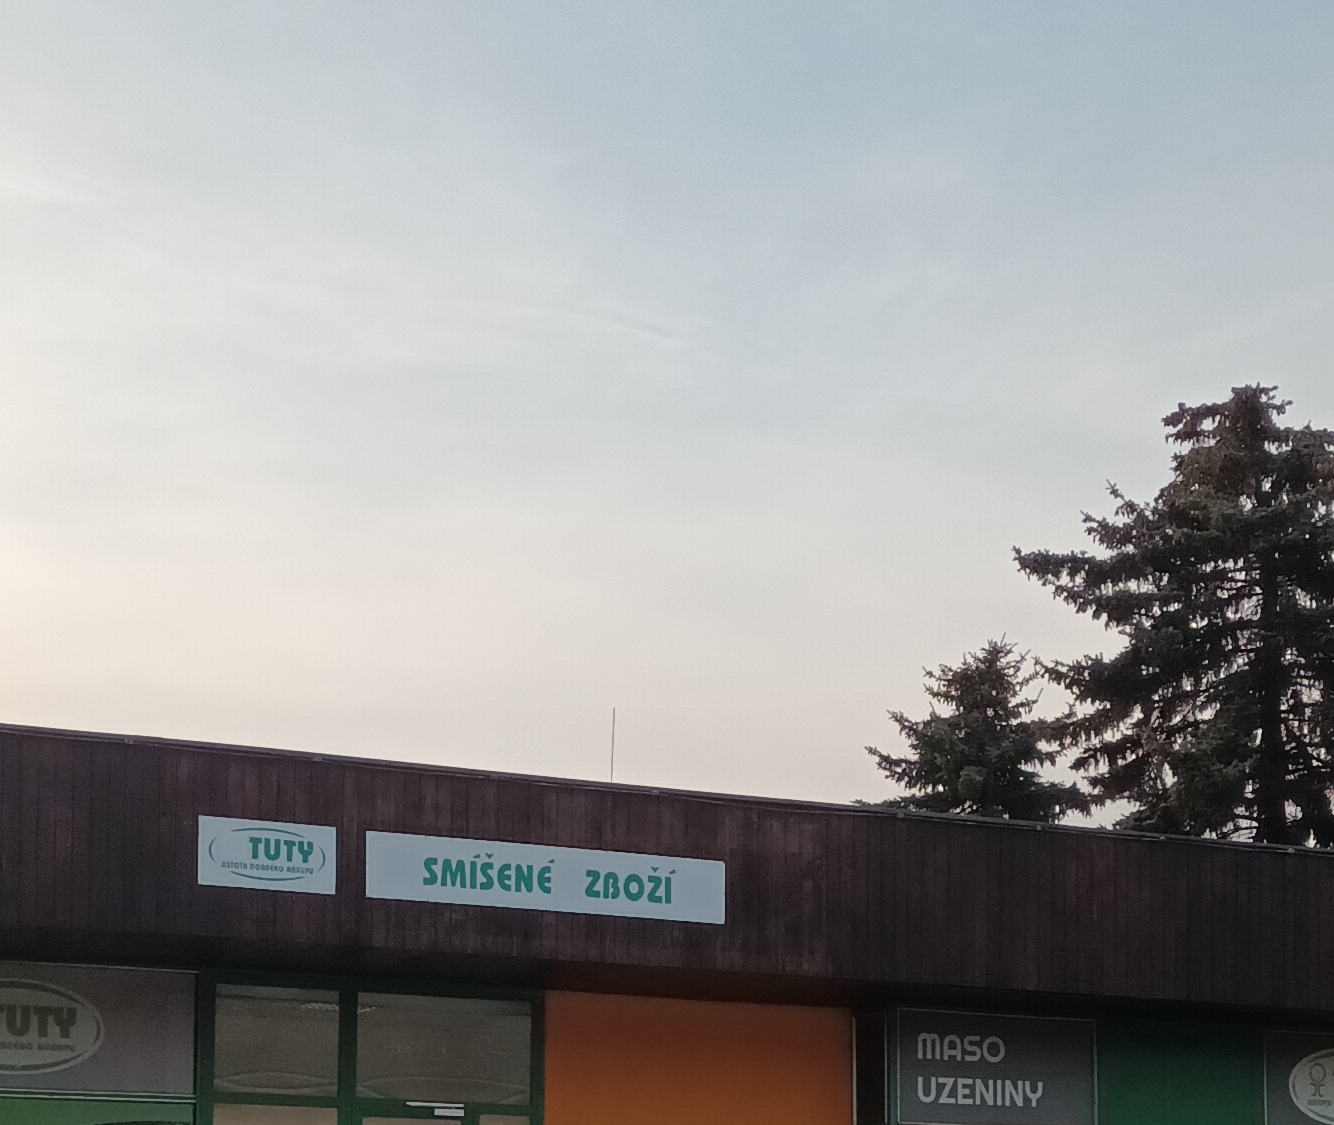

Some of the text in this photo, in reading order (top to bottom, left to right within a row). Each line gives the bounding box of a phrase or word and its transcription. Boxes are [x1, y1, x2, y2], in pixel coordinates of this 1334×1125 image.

[249, 836, 314, 864] TUTY
[423, 852, 677, 904] SMÍŠENÉ ZBOŽÍ
[917, 1032, 1006, 1063] MASO
[917, 1076, 1044, 1107] UZENINY
